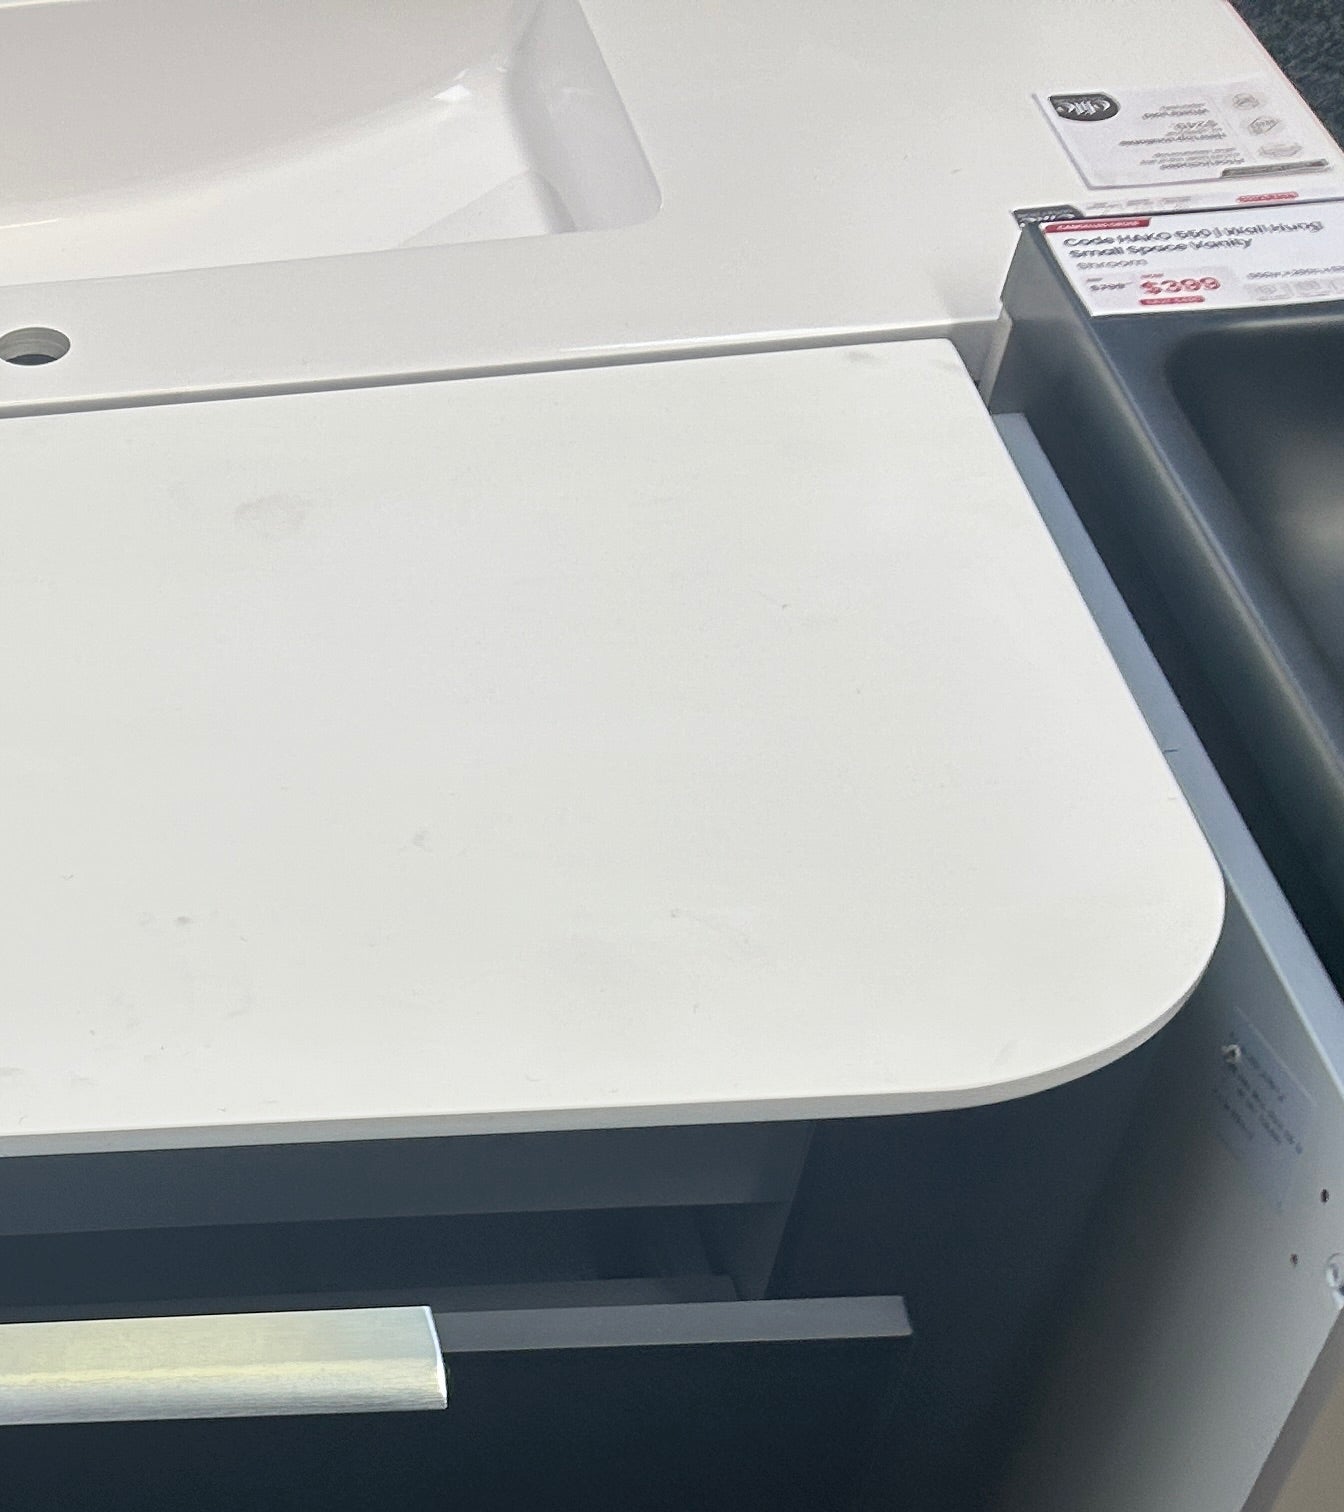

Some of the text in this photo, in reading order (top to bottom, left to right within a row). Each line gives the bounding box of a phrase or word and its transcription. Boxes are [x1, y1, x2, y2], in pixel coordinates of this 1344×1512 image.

[1063, 237, 1114, 247] Code
[1069, 238, 1253, 258] Small Space Vanity
[1140, 277, 1221, 295] $399
